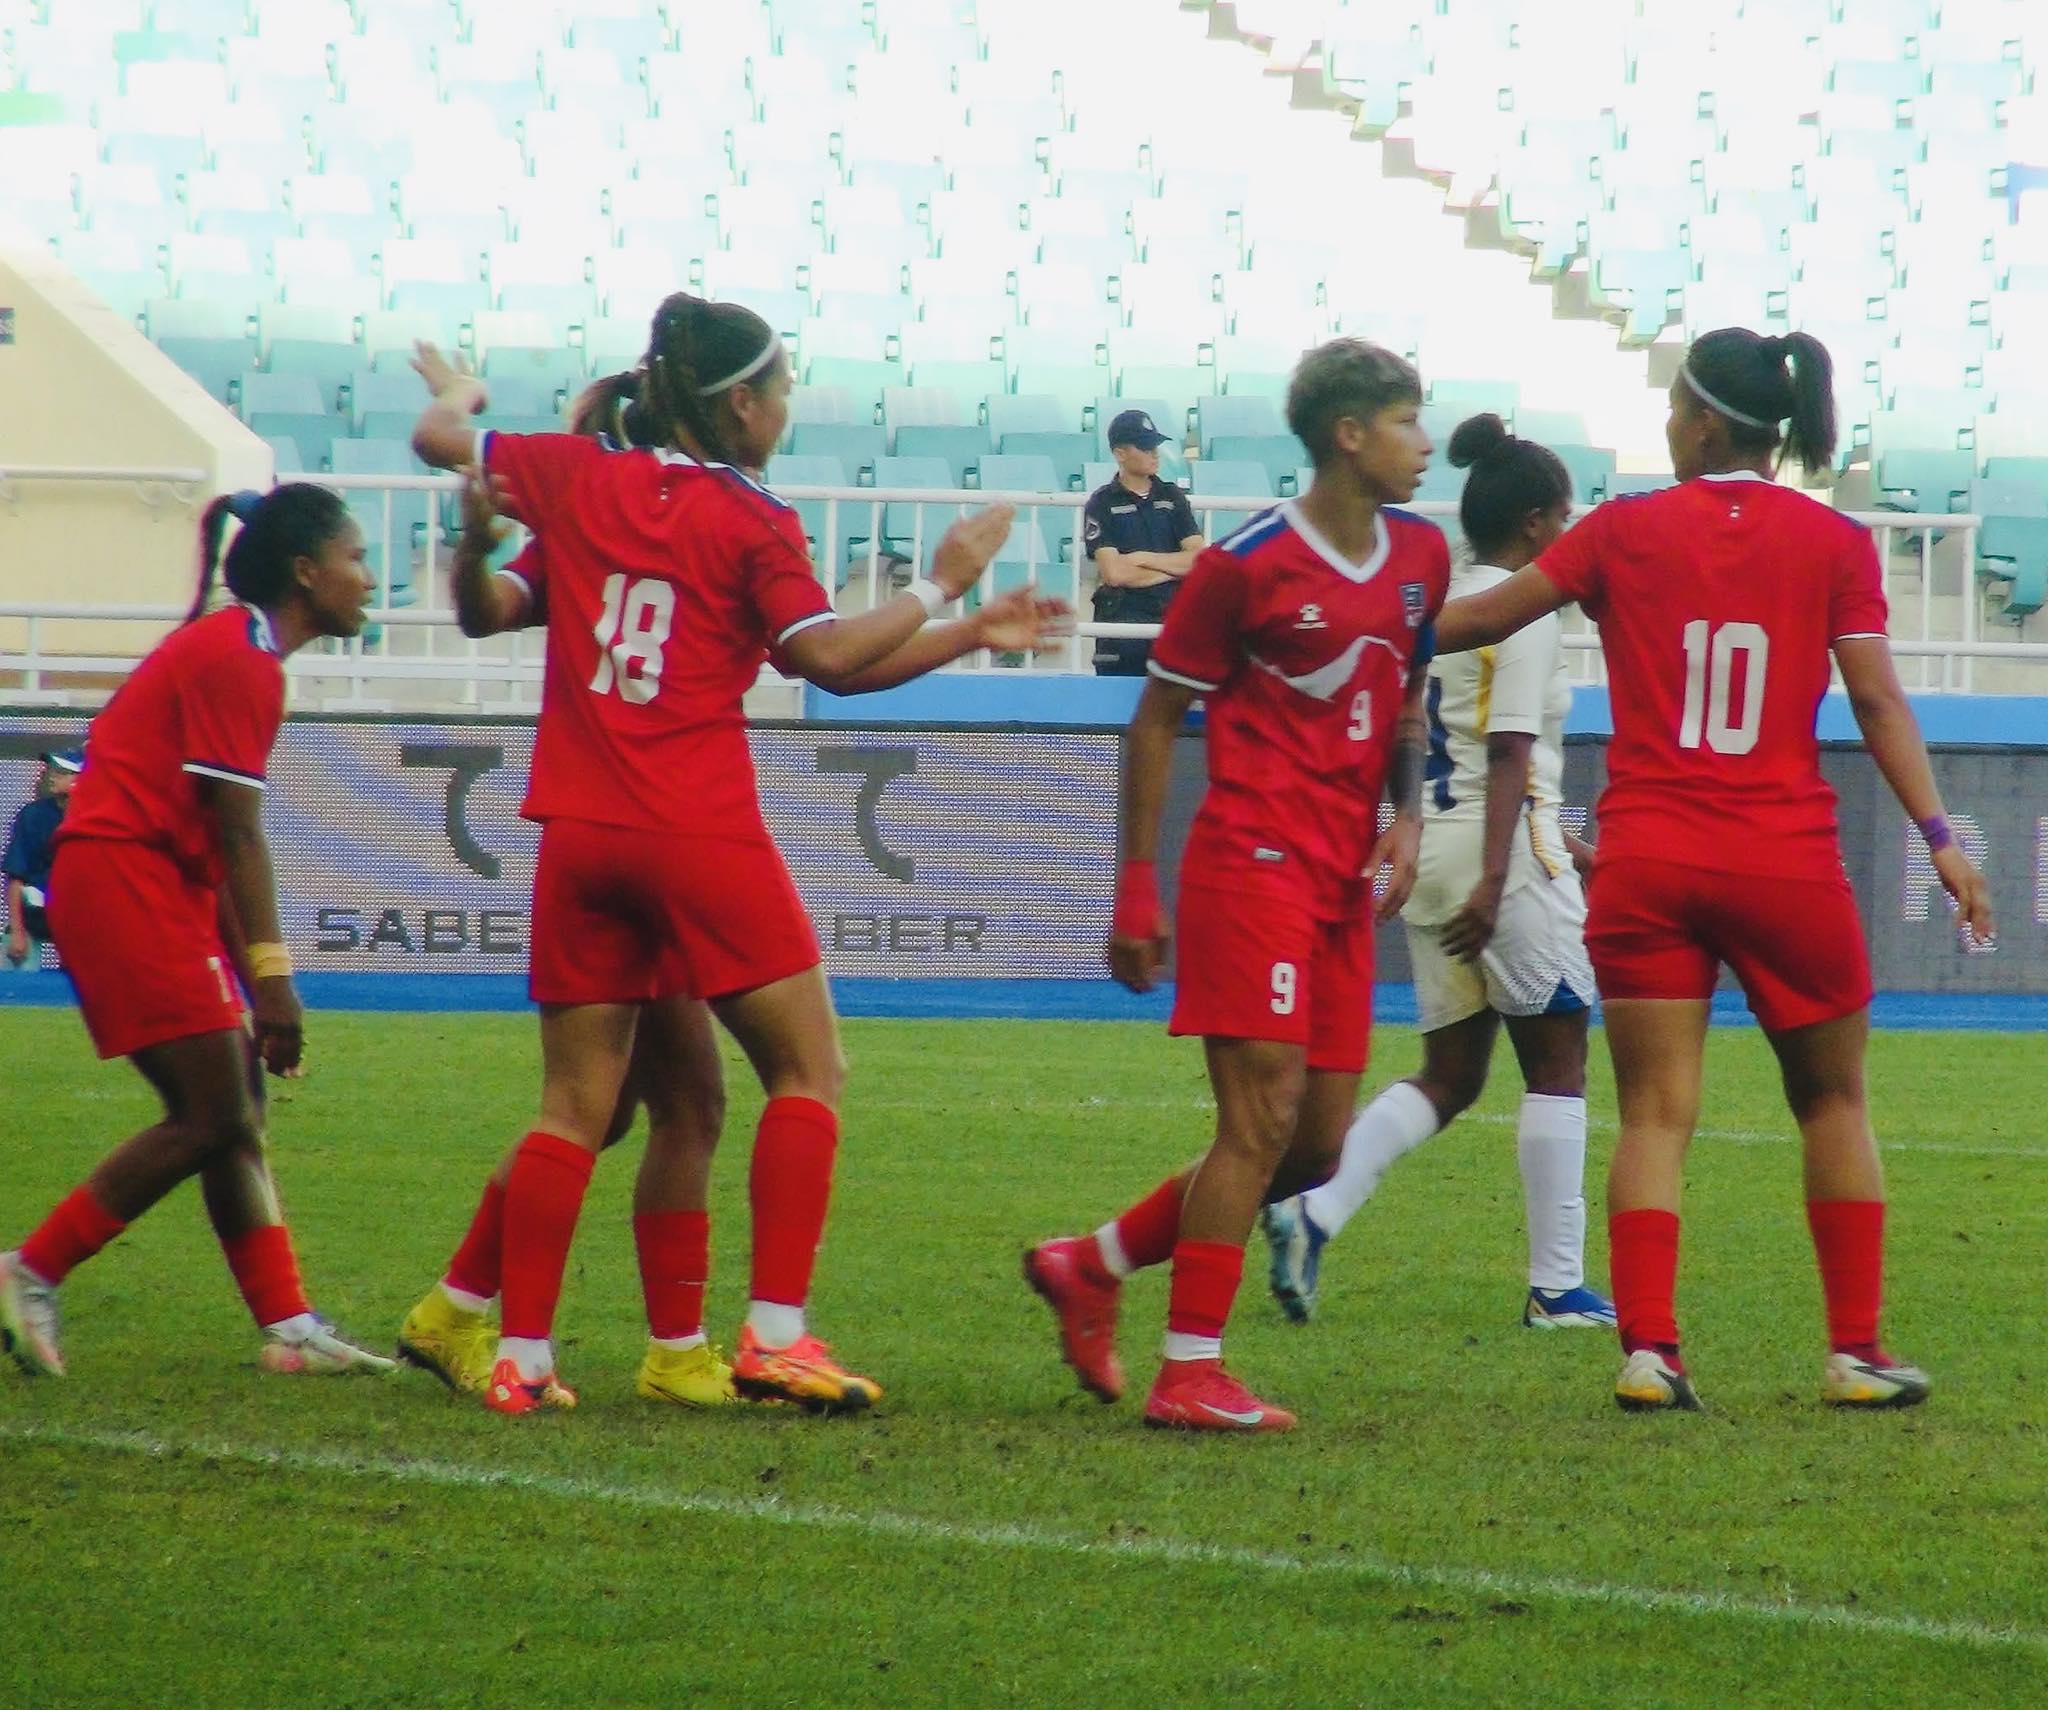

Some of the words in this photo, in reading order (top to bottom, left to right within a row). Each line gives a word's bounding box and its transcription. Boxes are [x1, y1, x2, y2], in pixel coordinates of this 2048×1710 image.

[588, 572, 677, 706] 18
[1678, 619, 1770, 755] 10
[1346, 690, 1373, 741] 9
[318, 908, 524, 953] SABE
[834, 914, 986, 951] BER
[1270, 961, 1297, 1015] 9
